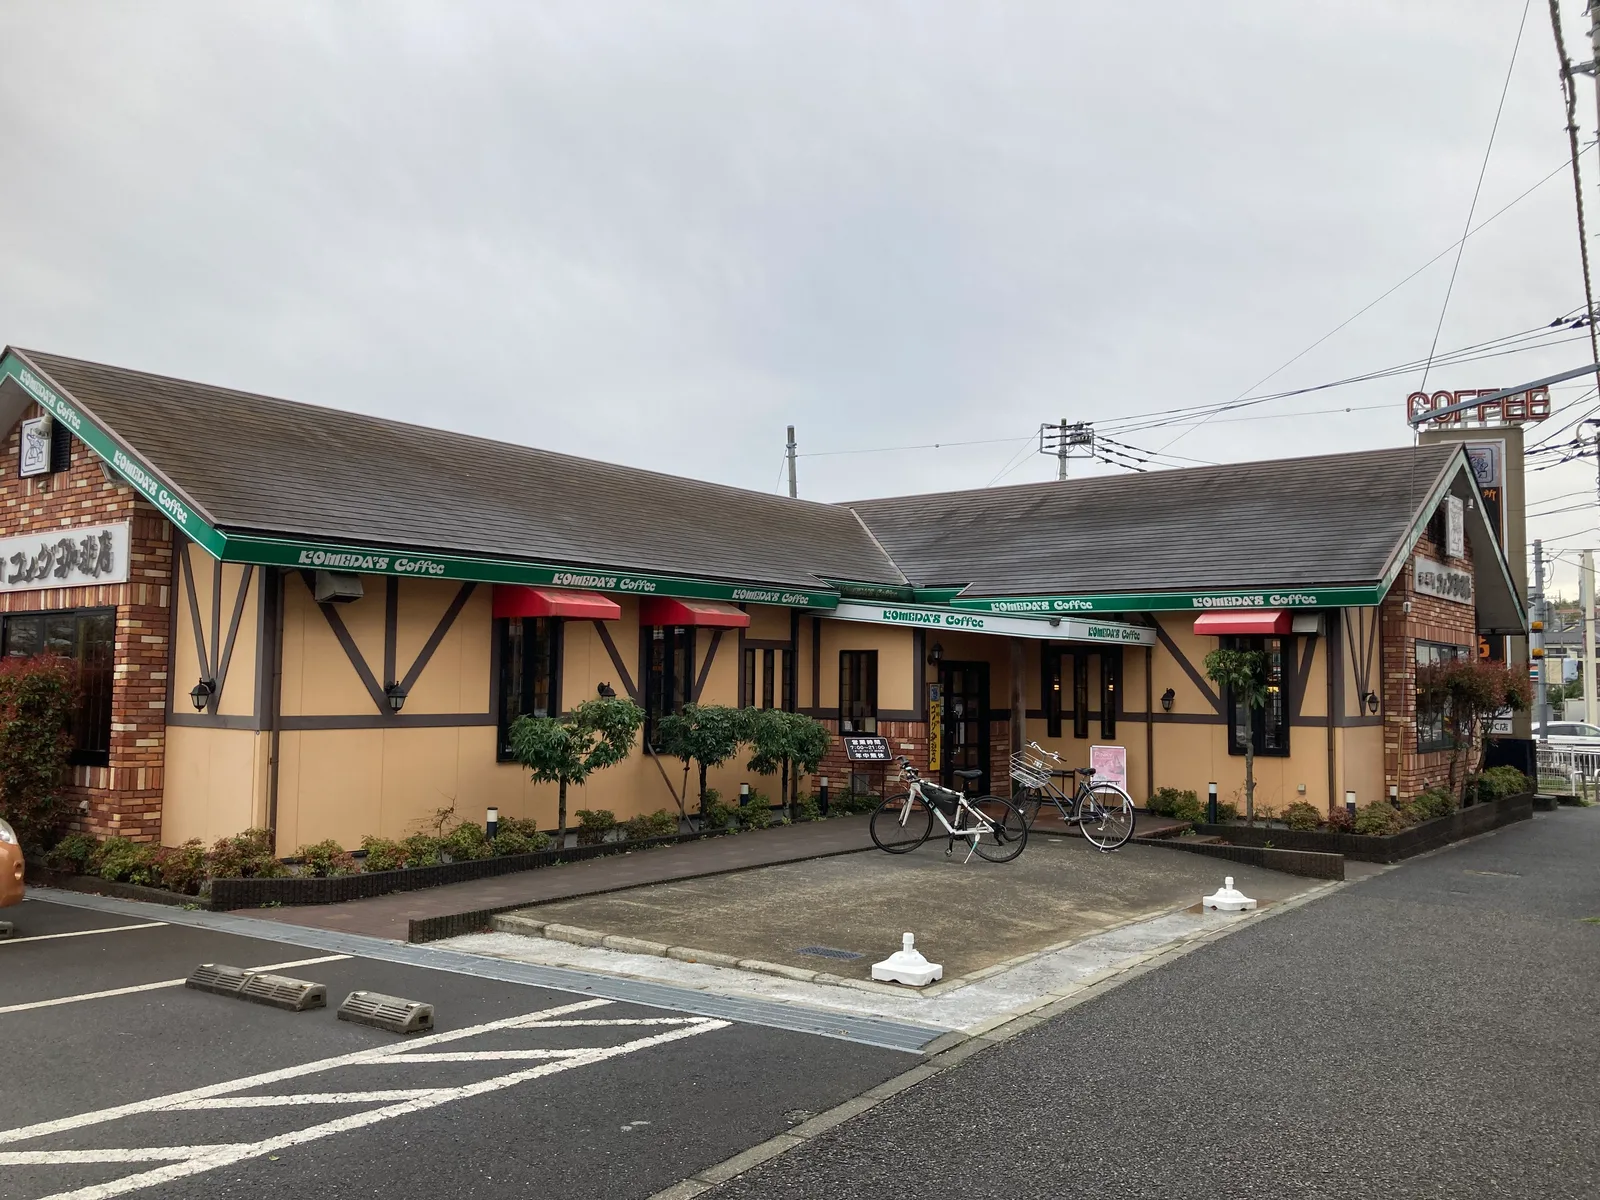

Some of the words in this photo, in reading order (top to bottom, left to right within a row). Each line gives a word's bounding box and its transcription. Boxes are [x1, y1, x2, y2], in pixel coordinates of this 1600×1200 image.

[1407, 385, 1549, 424] COFFEE
[56, 401, 81, 430] Coffee
[113, 450, 158, 496] KOMEDA'S
[159, 490, 188, 524] Coffee
[298, 550, 389, 570] KOMEDA'S
[394, 558, 445, 574] Coffee
[552, 572, 617, 589] KOMEDA'S
[620, 578, 656, 592] Coffee
[732, 589, 779, 601] KOMEDA'S
[781, 593, 809, 604] Coffee
[990, 601, 1050, 612] KOMEDA'S
[1053, 600, 1093, 610] Coffee
[1192, 595, 1264, 607] KOMEDA'S
[1269, 594, 1317, 605] Coffee
[882, 610, 941, 624] KOMEDA'S
[945, 615, 984, 628] Coffee
[1087, 626, 1120, 639] KOMEDA'S
[1121, 629, 1141, 641] Coffee
